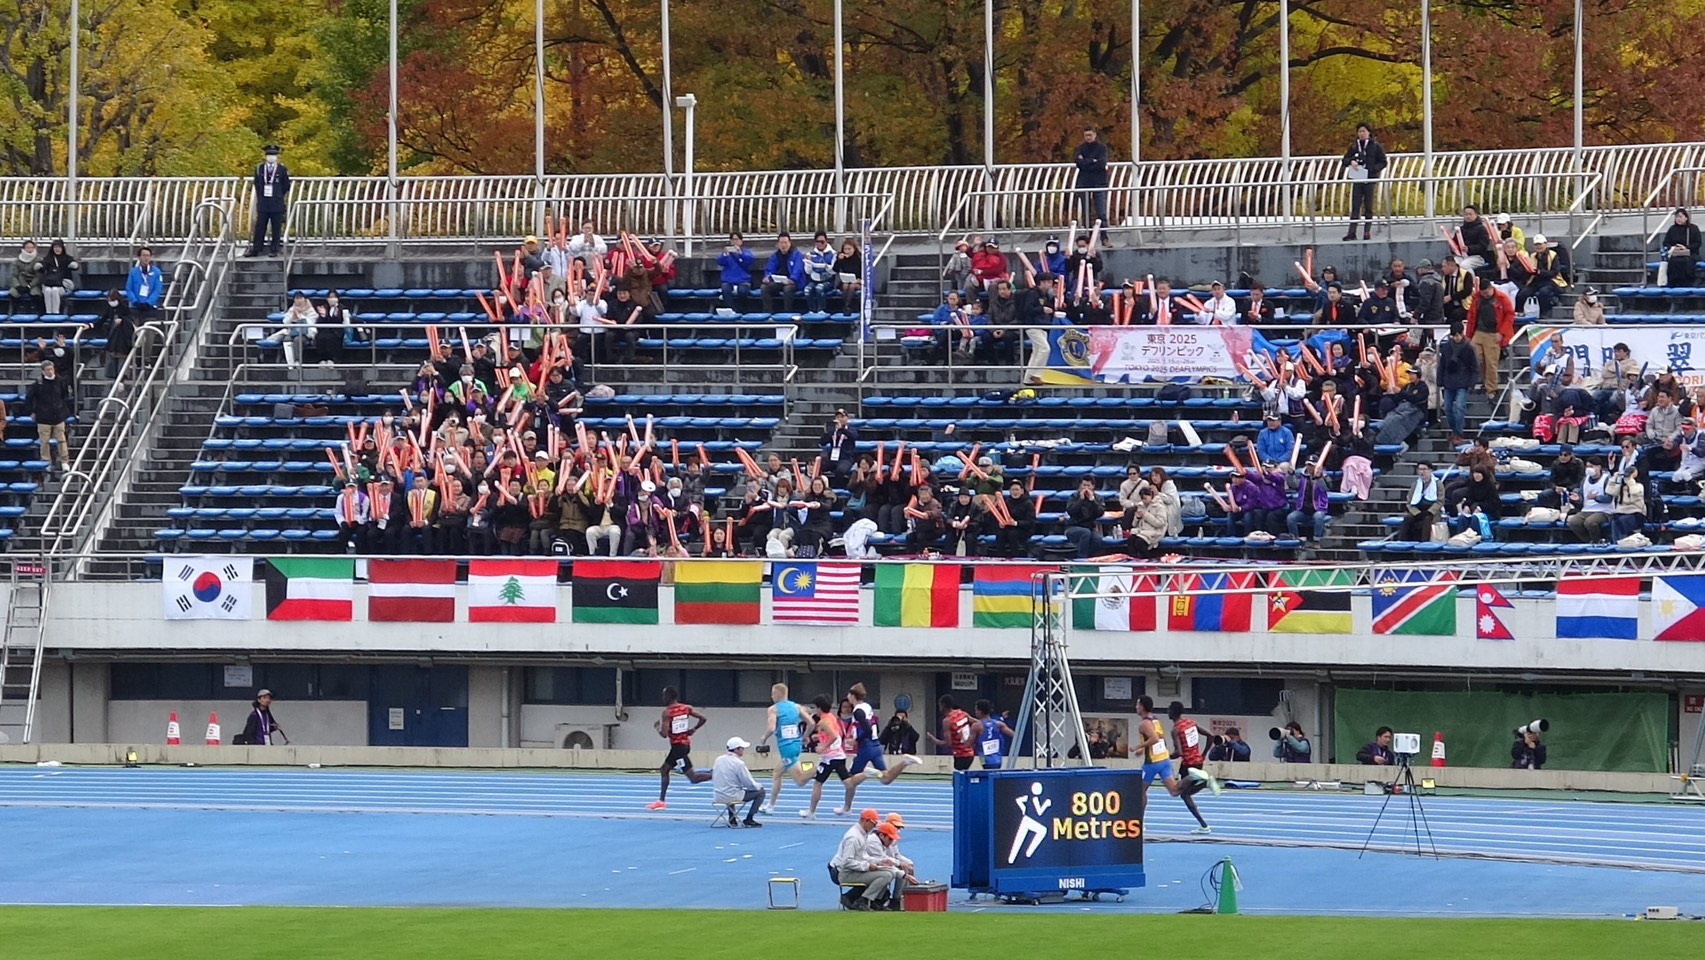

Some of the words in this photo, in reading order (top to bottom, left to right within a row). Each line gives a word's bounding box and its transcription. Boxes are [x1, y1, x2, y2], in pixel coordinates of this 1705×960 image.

[1146, 333, 1166, 344] 東京
[1170, 334, 1197, 344] 2025
[1141, 345, 1205, 357] デフリンピック
[1124, 364, 1150, 372] TOKYO
[1151, 365, 1168, 373] 2025
[1169, 365, 1218, 373] DEAFLYMPICS
[1071, 791, 1121, 816] 800
[1052, 817, 1141, 841] Metres
[1059, 878, 1085, 889] NISHI
